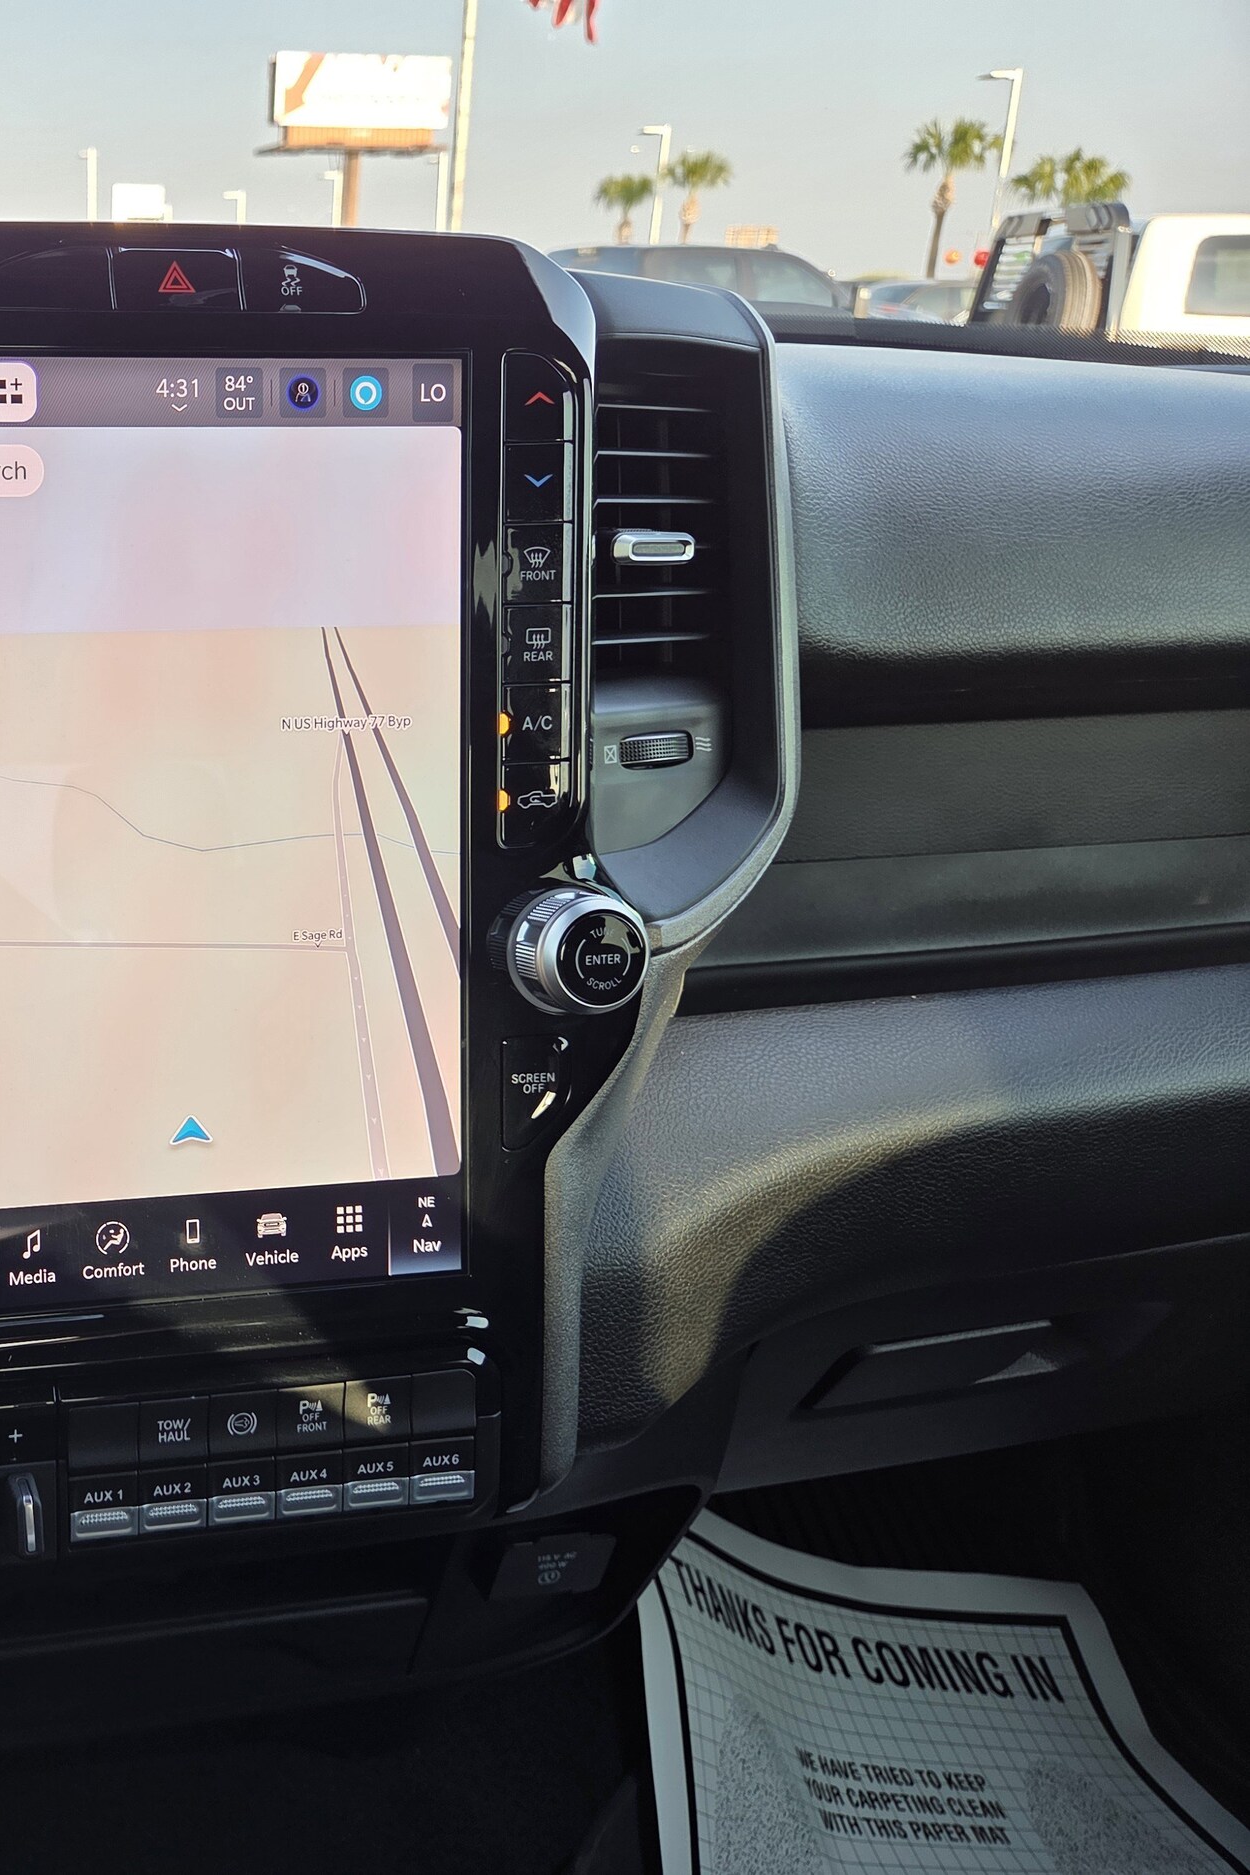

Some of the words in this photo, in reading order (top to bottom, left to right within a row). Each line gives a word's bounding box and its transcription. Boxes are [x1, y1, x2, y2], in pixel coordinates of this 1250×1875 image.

[281, 286, 302, 296] OFF
[155, 378, 200, 400] 4:31
[224, 374, 254, 393] 84°
[419, 383, 447, 403] LO
[223, 396, 255, 412] OUT
[520, 570, 556, 581] FRONT
[523, 651, 553, 662] REAR
[281, 719, 291, 730] N
[294, 718, 311, 729] US
[314, 717, 367, 731] Highway
[369, 716, 385, 728] 77
[388, 715, 411, 729] Byp
[522, 715, 553, 731] A/C
[293, 932, 299, 941] E
[302, 931, 327, 942] Sage
[329, 930, 342, 939] Rd
[585, 953, 621, 965] ENTER
[586, 976, 622, 990] SCROLL
[511, 1072, 555, 1084] SCREEN
[523, 1083, 544, 1094] OFF
[418, 1196, 435, 1208] NE
[413, 1238, 441, 1253] Nav
[245, 1249, 299, 1267] Vehicle
[331, 1245, 368, 1262] Apps
[82, 1261, 145, 1280] Comfort
[170, 1257, 217, 1273] Phone
[9, 1270, 56, 1286] Media
[302, 1412, 320, 1423] OFF
[370, 1405, 388, 1416] OFF
[157, 1418, 191, 1432] TOW/
[296, 1421, 327, 1433] FRONT
[367, 1414, 391, 1426] REAR
[158, 1430, 191, 1443] HAUL
[357, 1463, 384, 1475] AUX
[387, 1461, 394, 1472] 5
[422, 1456, 450, 1468] AUX
[452, 1454, 460, 1465] 6
[222, 1477, 250, 1489] AUX
[253, 1475, 260, 1486] 3
[290, 1470, 317, 1483] AUX
[319, 1468, 328, 1480] 4
[84, 1491, 113, 1504] AUX
[117, 1489, 124, 1500] 1
[153, 1484, 181, 1497] AUX
[184, 1482, 192, 1494] 2
[669, 1555, 777, 1657] THANKS
[777, 1616, 851, 1679] FOR
[851, 1636, 1014, 1700] COMING
[1011, 1654, 1065, 1704] IN
[794, 1746, 818, 1773] WE
[818, 1754, 862, 1782] HAVE
[861, 1763, 914, 1788] TRIED
[915, 1769, 942, 1790] TO
[942, 1771, 986, 1793] KEEP
[803, 1775, 845, 1806] YOUR
[846, 1788, 948, 1816] CARPETING
[948, 1797, 1009, 1820] CLEAN
[818, 1808, 863, 1837] WITH
[863, 1817, 908, 1840] THIS
[908, 1821, 972, 1844] PAPER
[970, 1824, 1012, 1846] MAT
